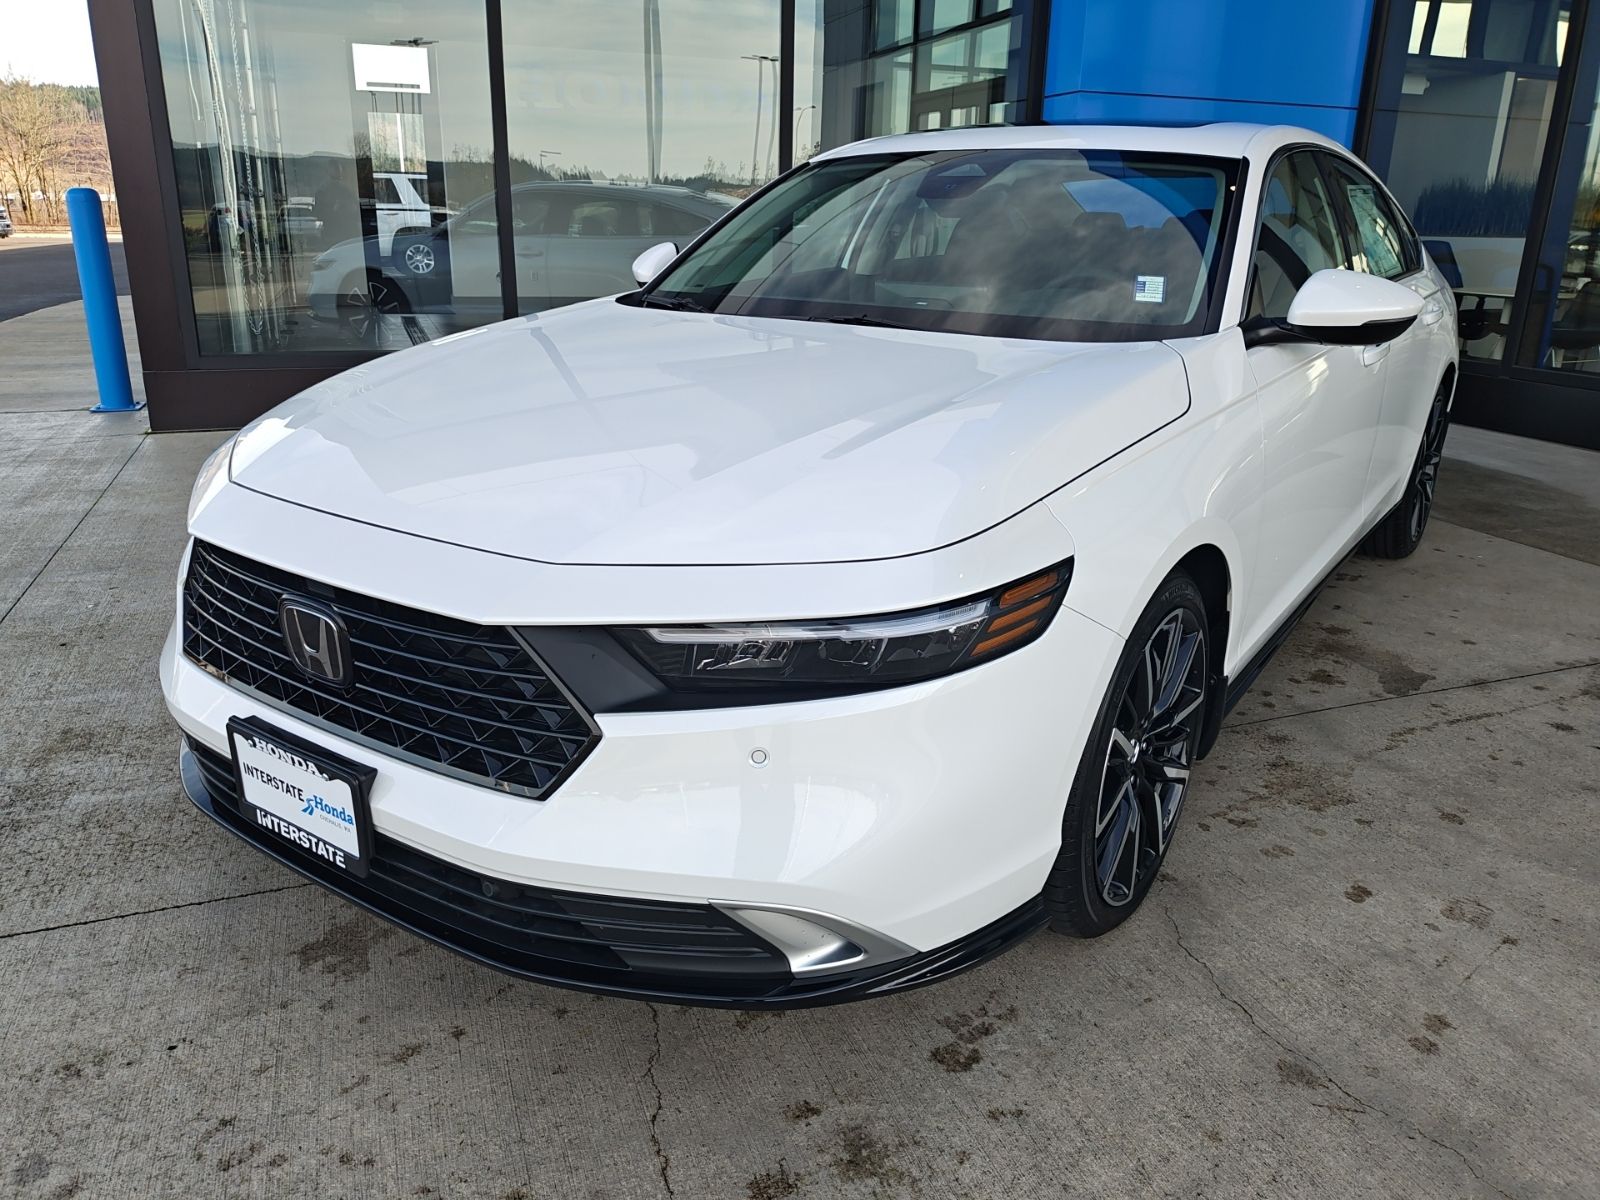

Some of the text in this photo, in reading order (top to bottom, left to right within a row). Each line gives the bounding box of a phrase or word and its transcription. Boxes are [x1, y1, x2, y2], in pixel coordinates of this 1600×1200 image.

[253, 736, 323, 776] HONDA
[243, 763, 305, 802] INTERSTATE
[313, 795, 354, 825] Honda
[256, 809, 346, 869] INTERSTATE
